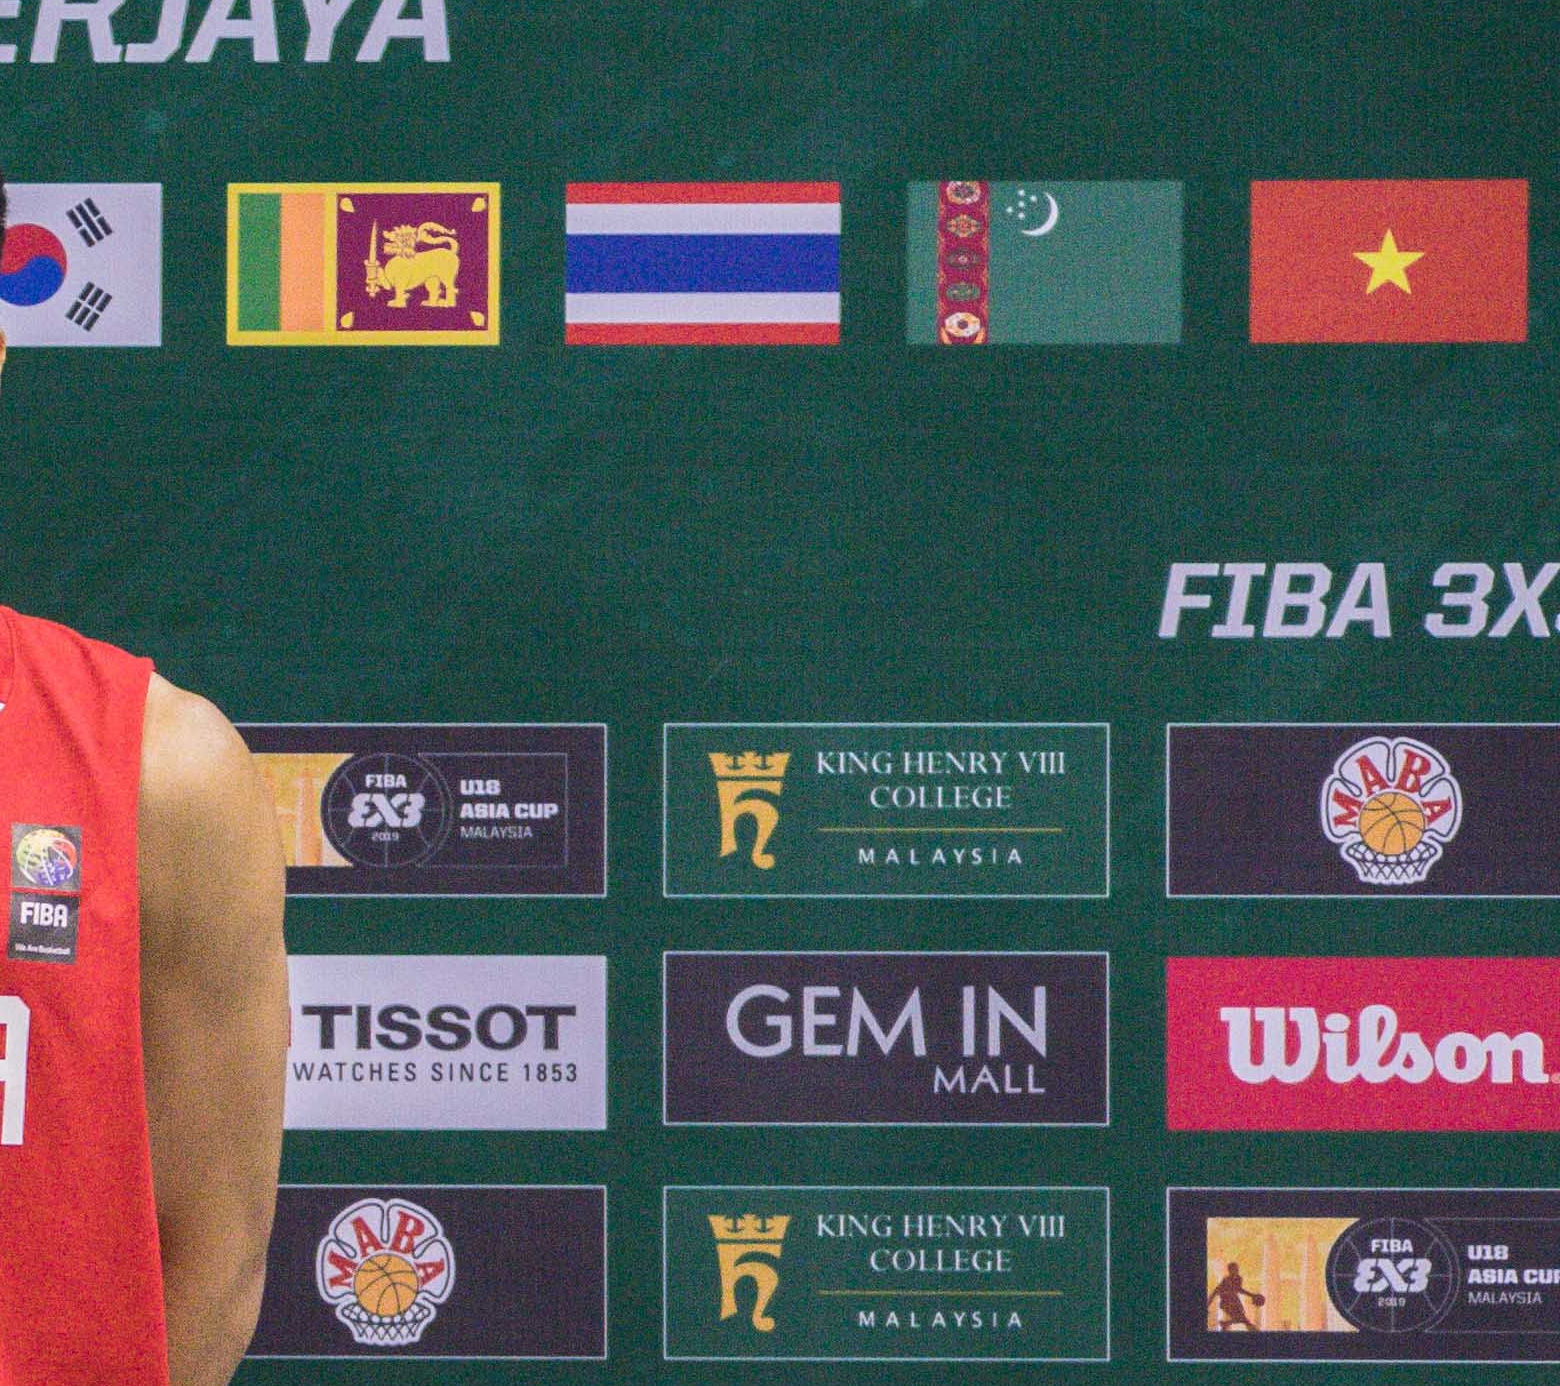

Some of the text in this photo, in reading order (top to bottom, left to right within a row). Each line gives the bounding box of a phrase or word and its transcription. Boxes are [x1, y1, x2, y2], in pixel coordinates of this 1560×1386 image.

[1158, 562, 1560, 638] FIBA 3X
[365, 774, 407, 788] FIBA
[460, 780, 500, 795] U18
[1334, 751, 1451, 830] MABA
[460, 803, 558, 818] ASIA CUP
[21, 901, 67, 927] FIBA
[303, 1004, 576, 1051] TISSOT
[726, 984, 1046, 1057] GEM IN
[431, 1062, 508, 1082] SINCE
[524, 1063, 577, 1083] 1853
[934, 1065, 1045, 1093] MALL
[329, 1212, 444, 1291] MABA
